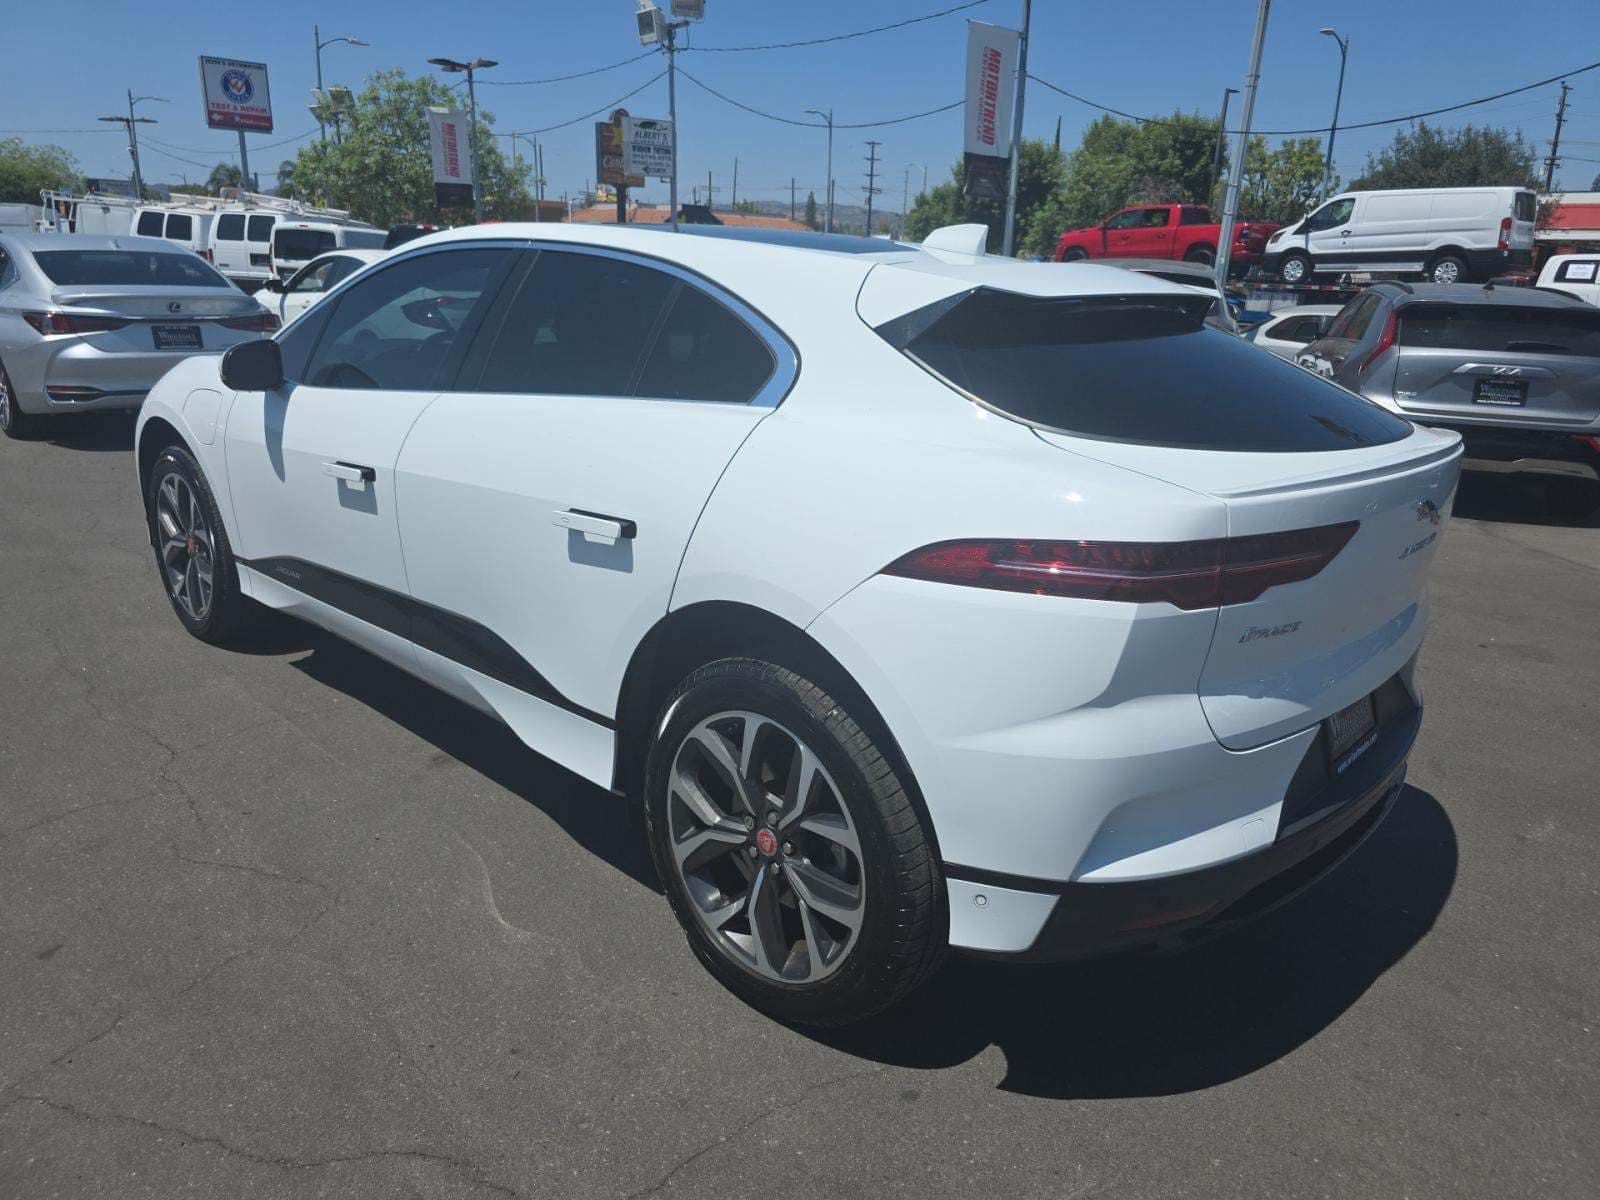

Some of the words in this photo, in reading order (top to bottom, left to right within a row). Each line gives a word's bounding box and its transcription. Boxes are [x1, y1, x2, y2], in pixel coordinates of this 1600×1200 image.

[982, 47, 1002, 146] MOTORTREND
[211, 102, 231, 110] TEST
[634, 130, 669, 141] ALBERT'S
